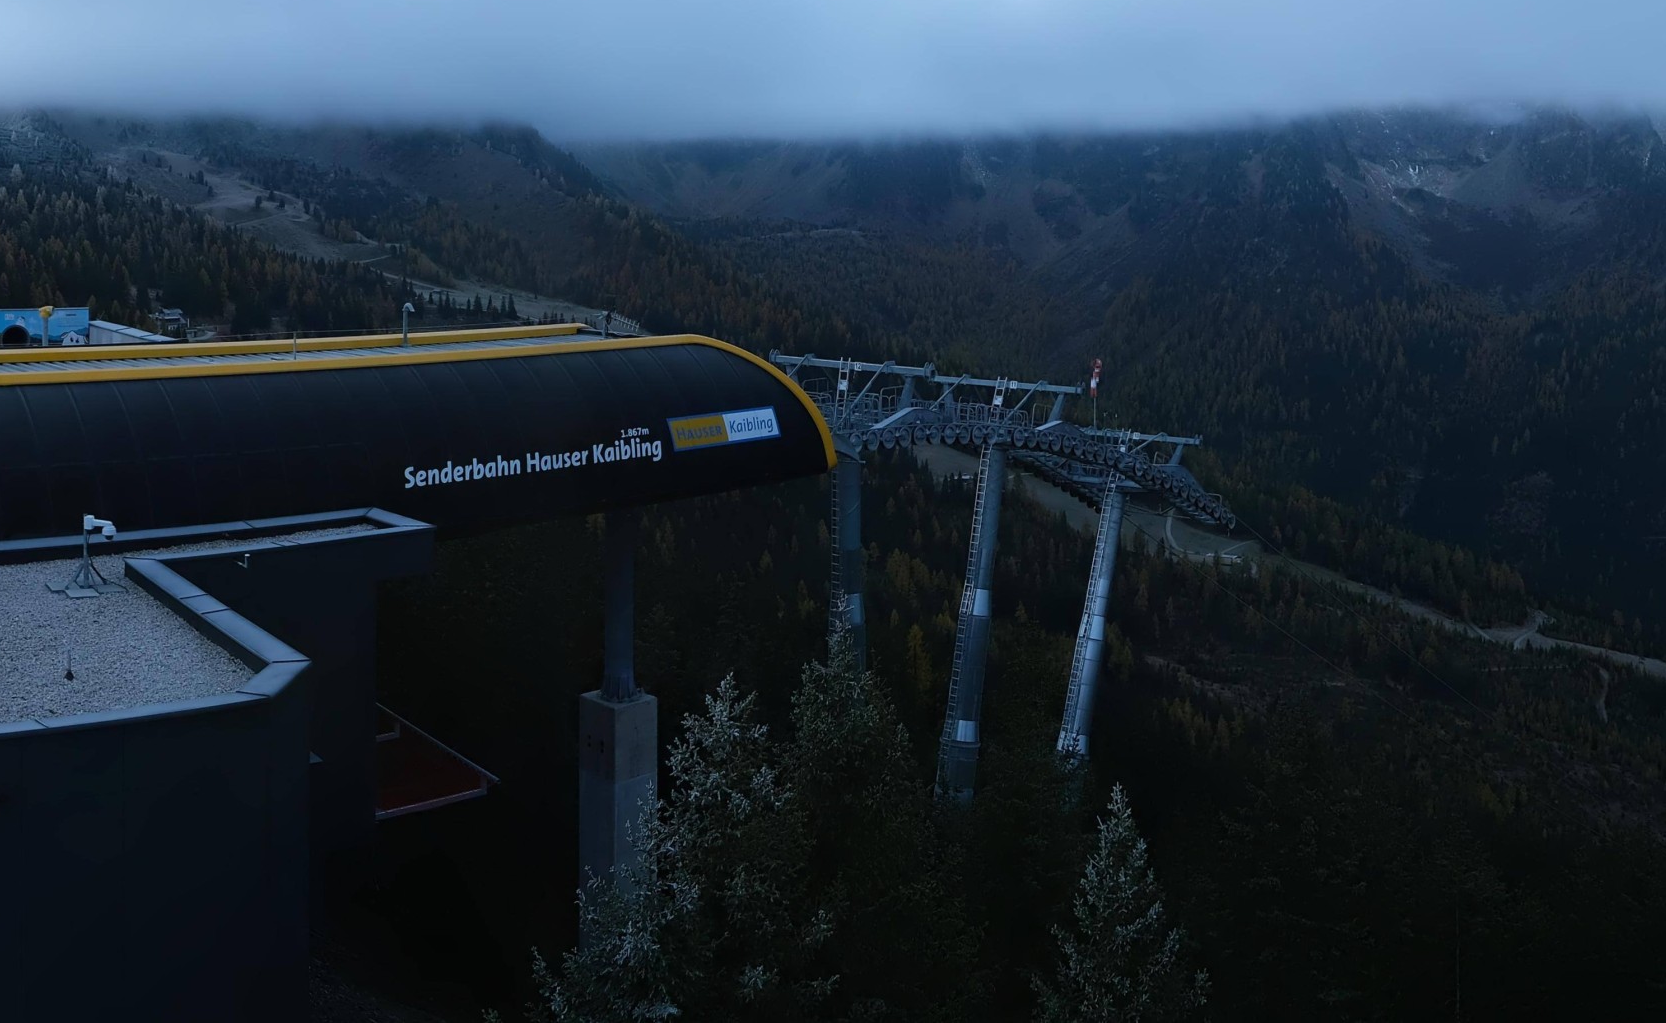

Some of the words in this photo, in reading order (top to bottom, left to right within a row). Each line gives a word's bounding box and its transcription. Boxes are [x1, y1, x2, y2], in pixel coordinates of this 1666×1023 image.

[620, 427, 650, 439] 1.867m
[677, 425, 723, 441] HAUSER
[729, 417, 774, 434] Kaibling
[404, 455, 522, 489] Senderbahn
[526, 449, 589, 473] Hauser
[592, 437, 663, 465] Kaibling
